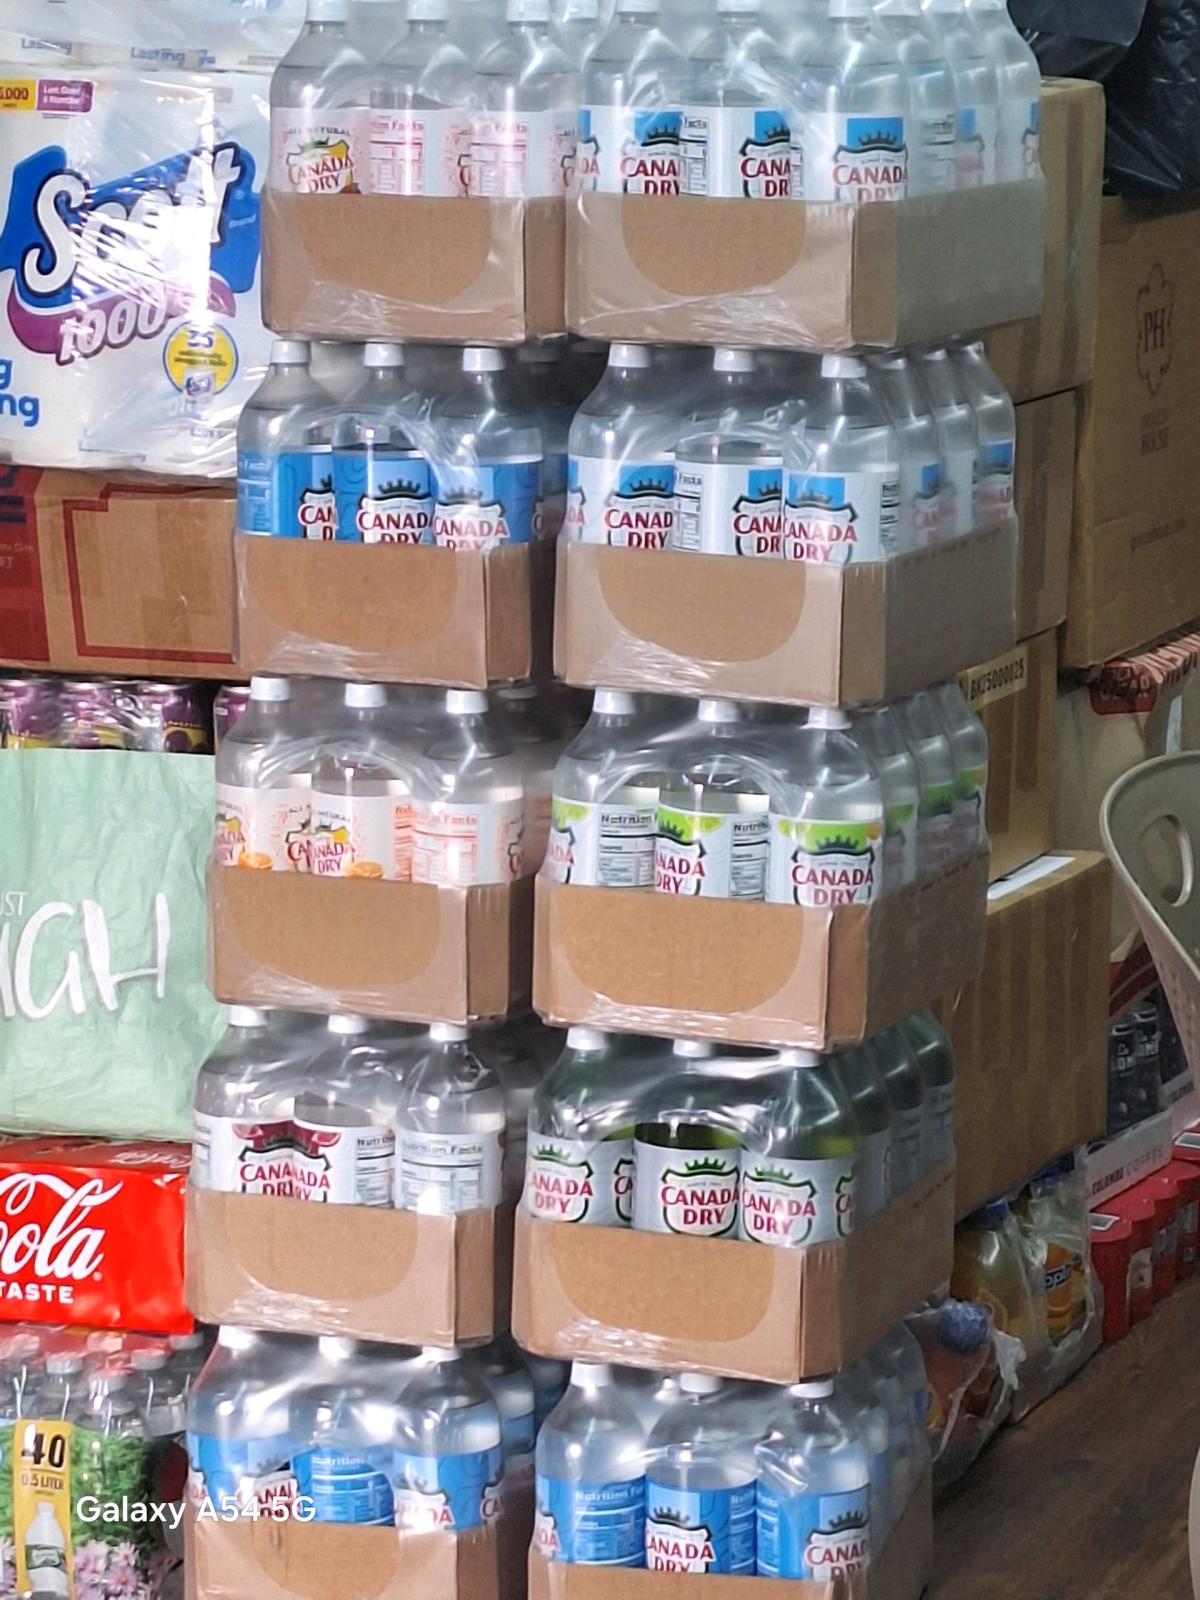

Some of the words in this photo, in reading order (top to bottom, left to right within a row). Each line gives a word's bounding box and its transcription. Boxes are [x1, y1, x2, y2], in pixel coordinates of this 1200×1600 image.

[21, 37, 73, 55] Lasng
[620, 157, 681, 178] CANA
[308, 172, 341, 193] DRY
[57, 285, 169, 365] 1000
[1143, 307, 1166, 352] PH
[604, 508, 673, 529] CANAD
[627, 531, 669, 549] DRY
[793, 542, 834, 561] DRY
[318, 859, 342, 874] DRY
[791, 865, 875, 888] CANADA
[813, 888, 858, 906] DRY
[529, 1172, 594, 1197] ANADA
[660, 1184, 741, 1206] CANADA
[533, 1195, 571, 1214] DRY
[743, 1188, 816, 1217] CANADA
[682, 1207, 728, 1226] DRY
[752, 1214, 793, 1235] DRY
[21, 1432, 66, 1468] 40
[312, 1455, 365, 1466] utrition
[646, 1535, 714, 1562] ANADA
